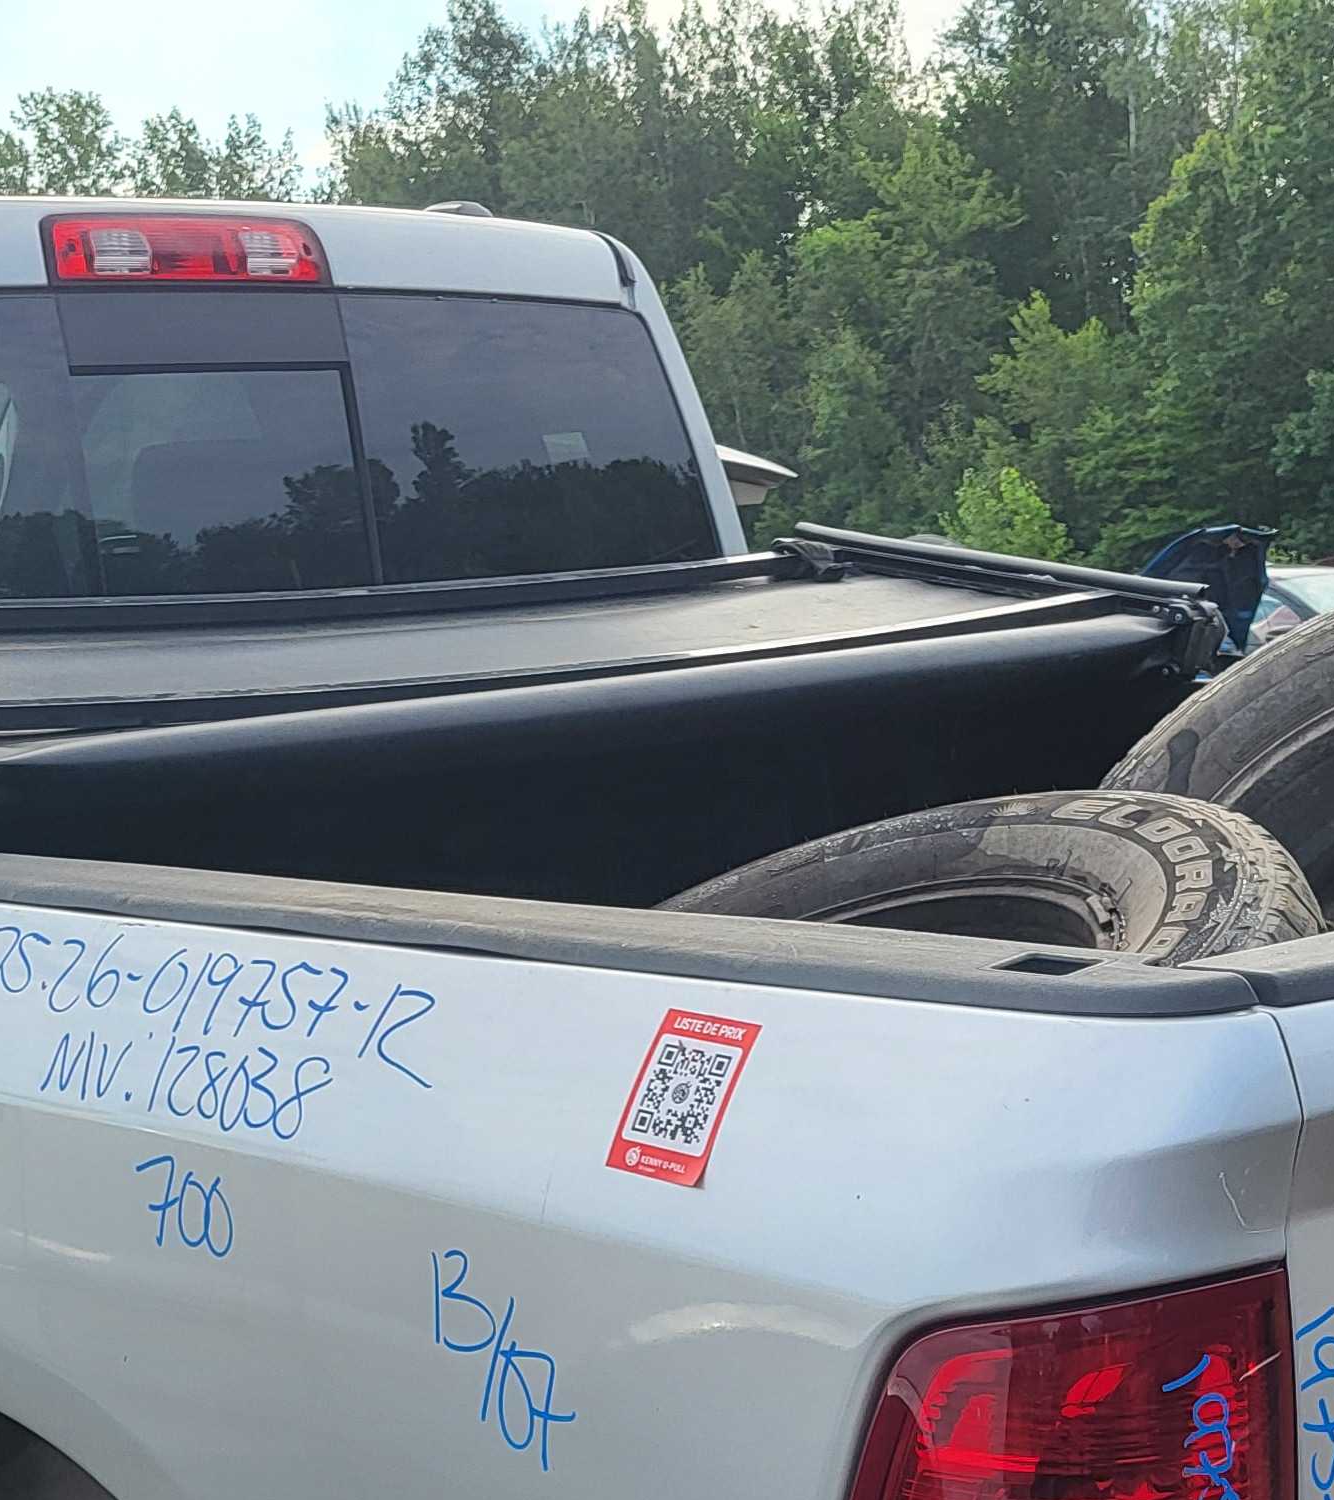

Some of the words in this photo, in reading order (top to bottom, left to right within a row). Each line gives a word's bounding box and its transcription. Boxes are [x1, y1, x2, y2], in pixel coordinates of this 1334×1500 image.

[673, 1015, 705, 1032] LISTE
[703, 1021, 720, 1036] DE
[718, 1024, 748, 1042] PRIX
[135, 1155, 235, 1258] 700
